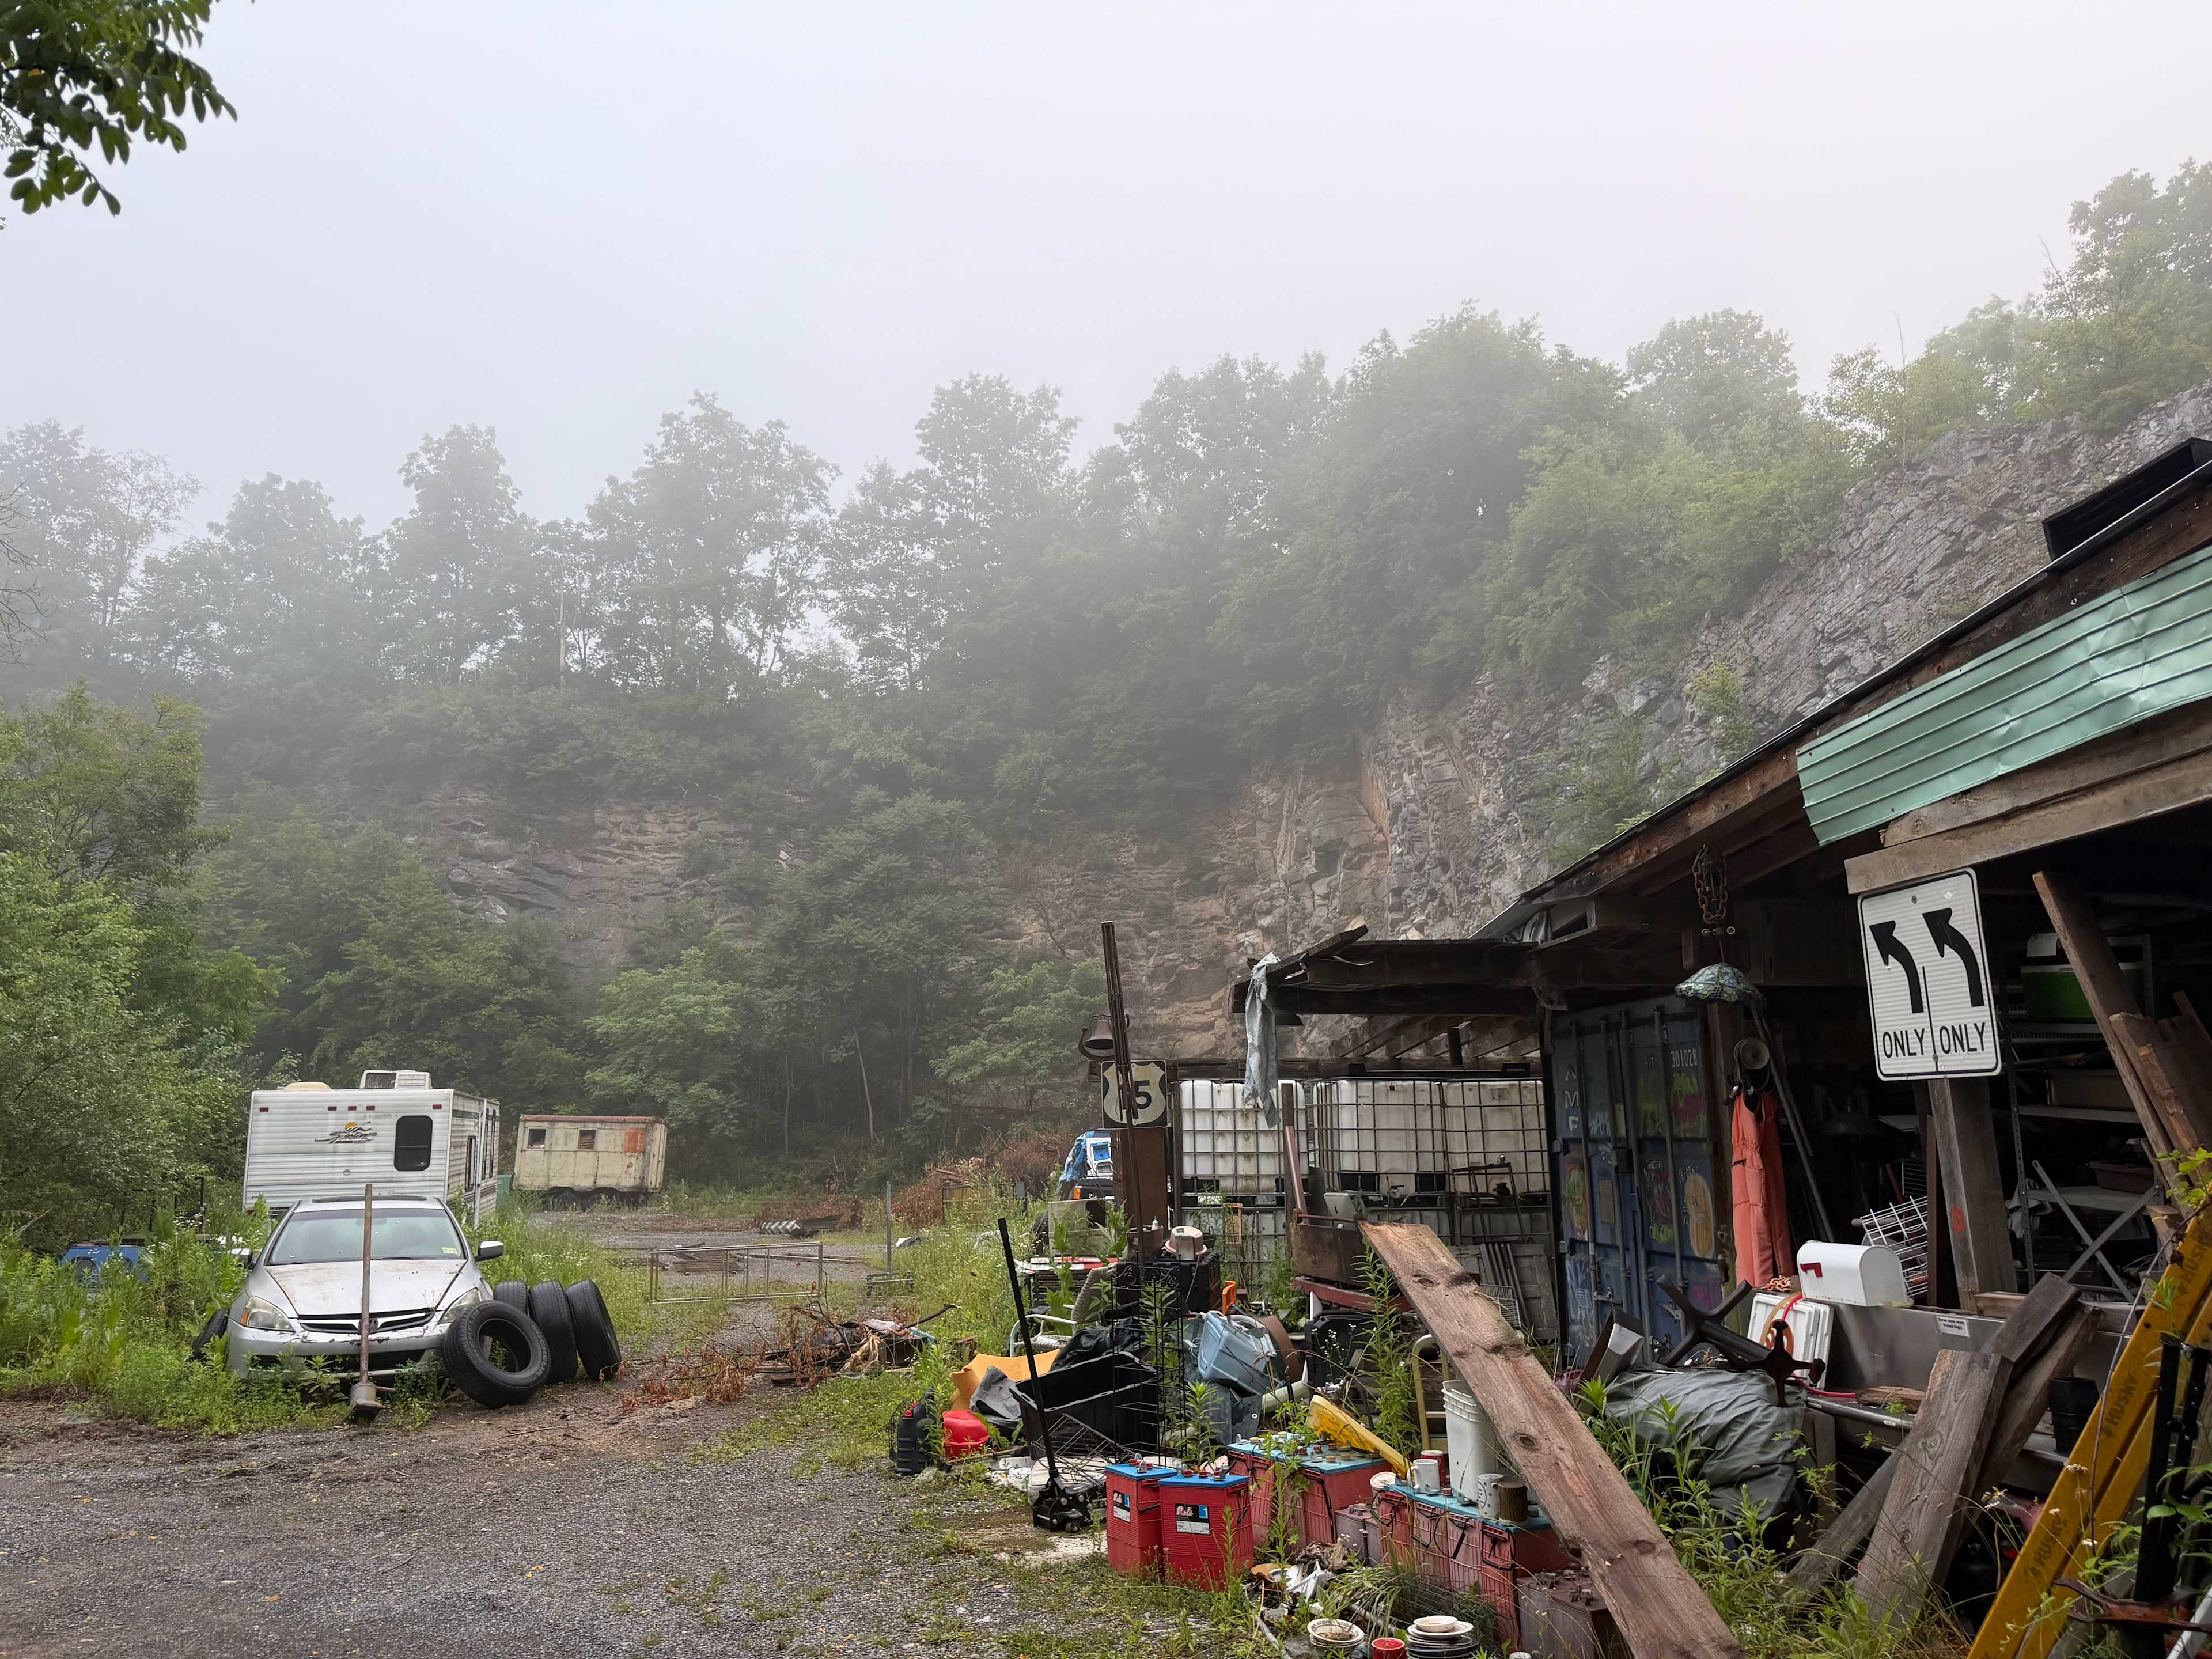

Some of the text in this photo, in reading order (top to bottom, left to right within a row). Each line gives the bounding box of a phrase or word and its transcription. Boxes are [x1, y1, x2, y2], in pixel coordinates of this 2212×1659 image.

[1671, 1048, 1697, 1067] 301028
[1882, 1022, 1986, 1058] ONLY ONLY
[2105, 1372, 2139, 1426] HUSKY
